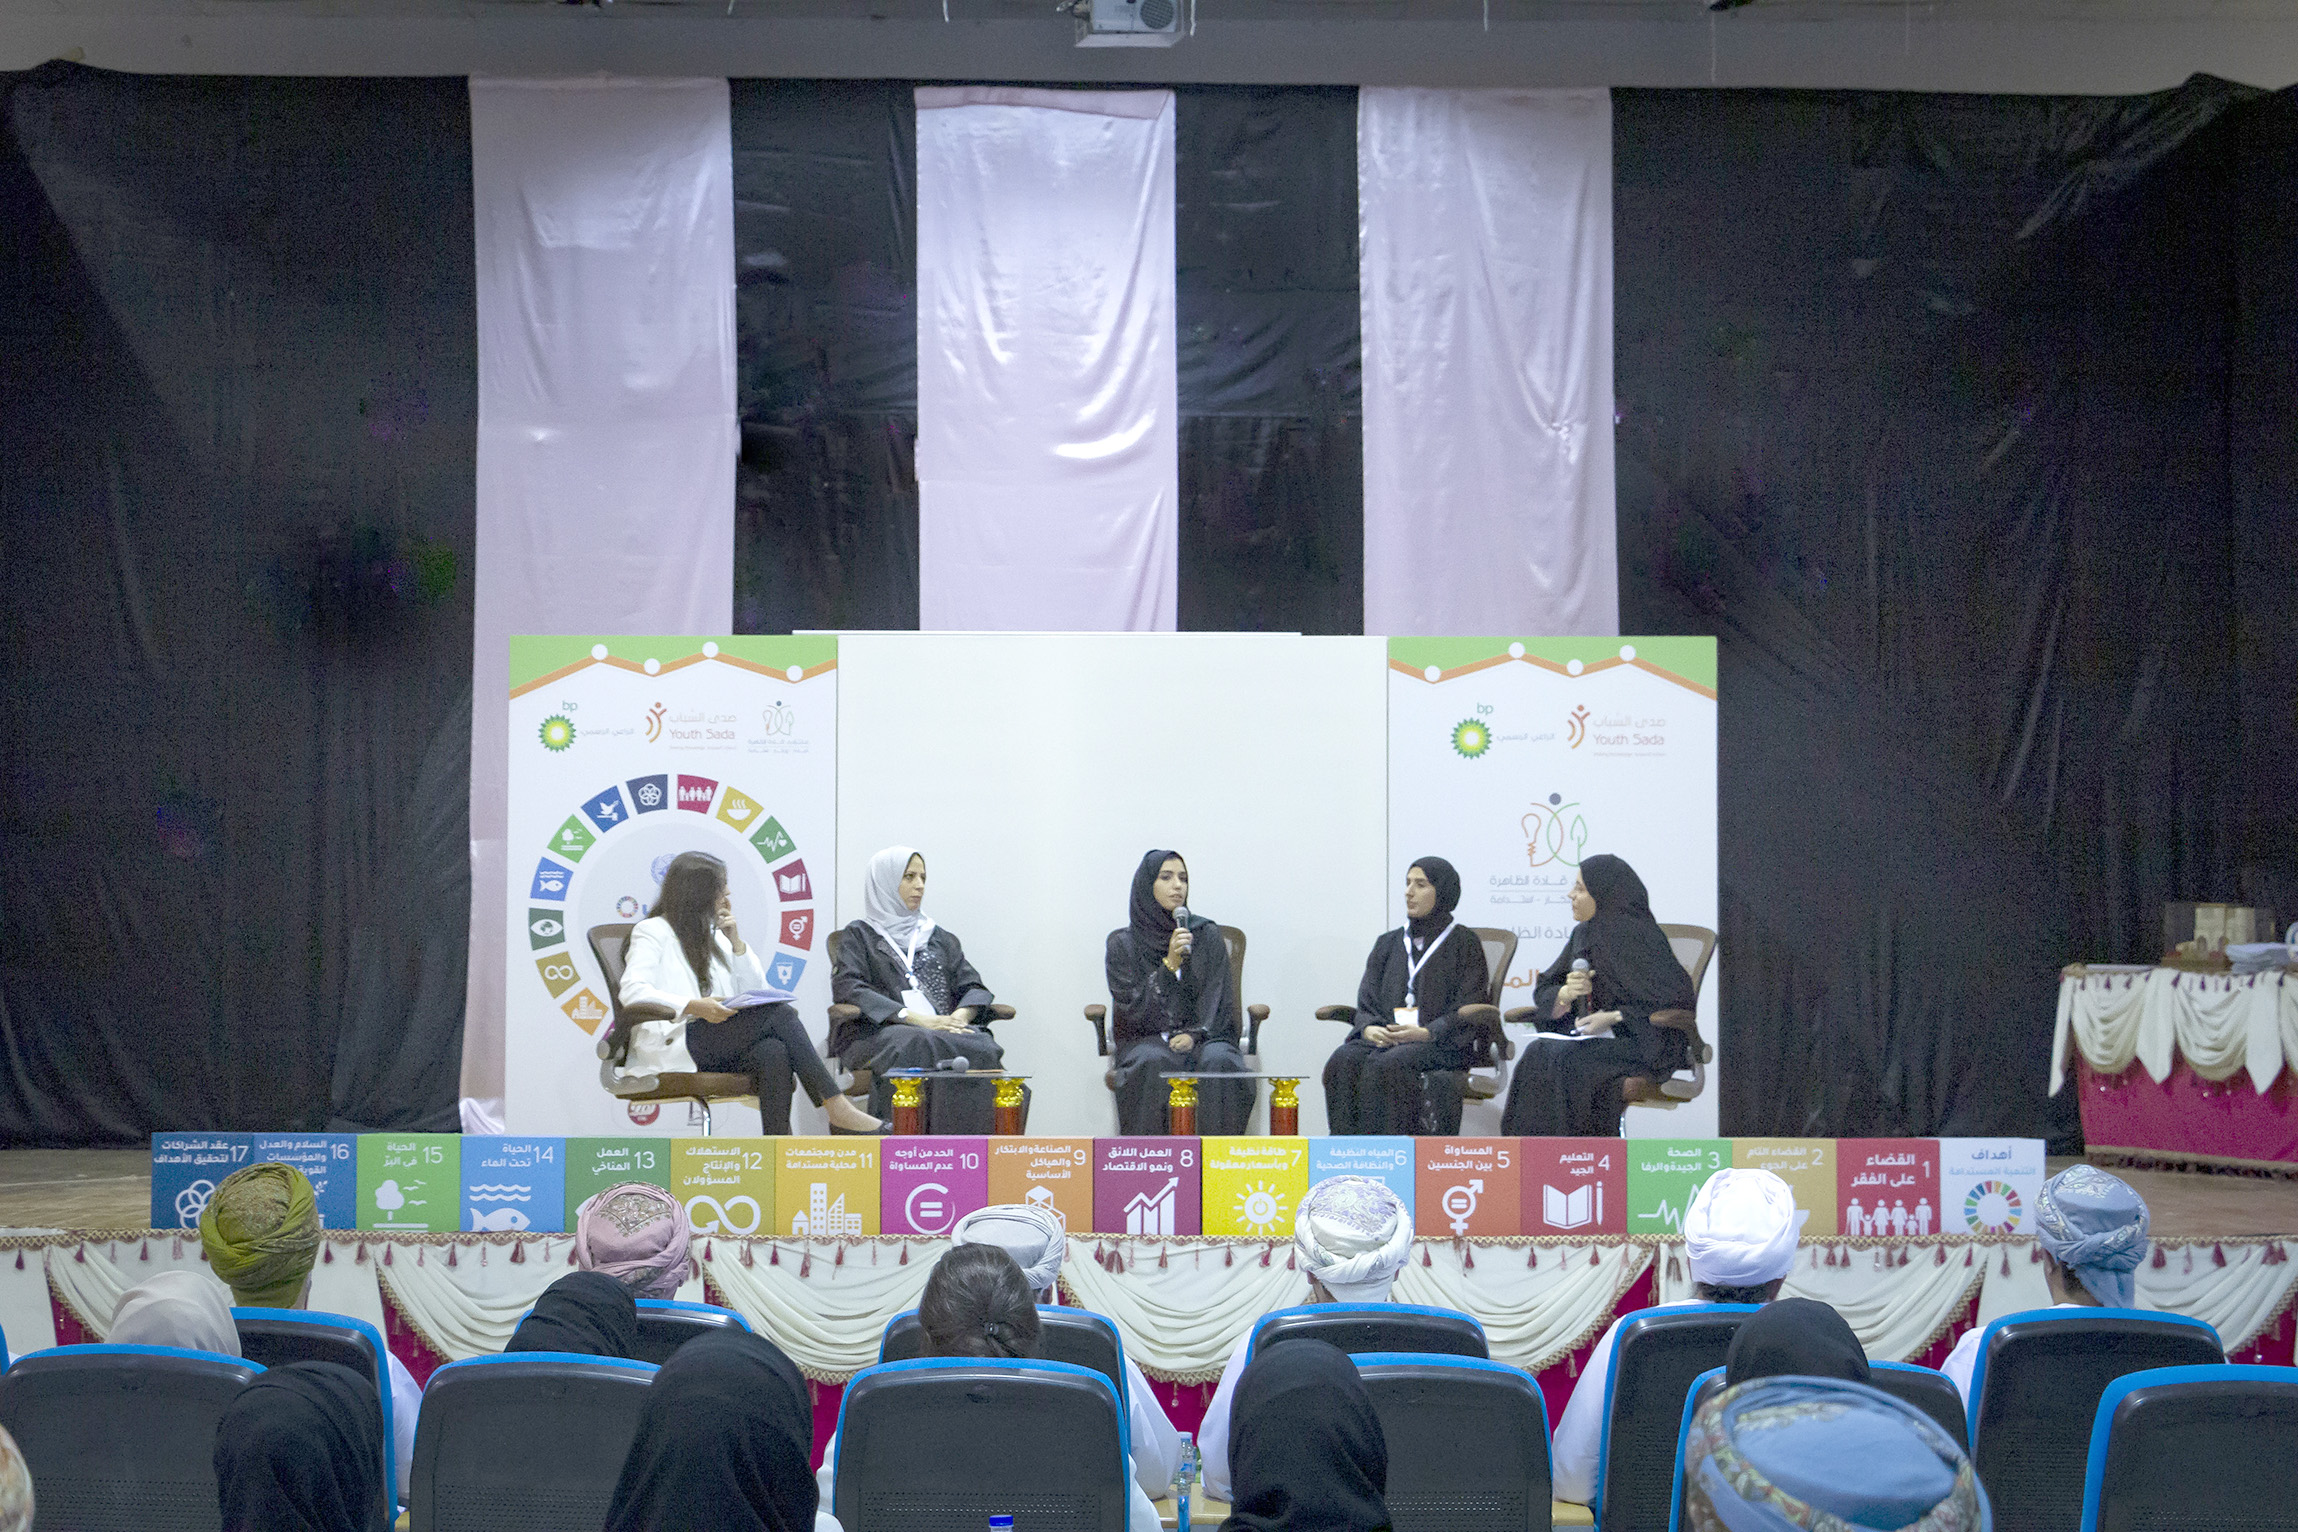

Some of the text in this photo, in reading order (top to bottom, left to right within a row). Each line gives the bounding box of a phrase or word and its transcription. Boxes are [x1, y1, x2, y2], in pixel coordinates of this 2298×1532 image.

[562, 701, 578, 712] bp
[1477, 702, 1494, 715] bp
[669, 728, 736, 740] Youth Sada
[1593, 733, 1665, 746] Youth Sada
[161, 1139, 229, 1151] عقد الشراكات
[259, 1140, 327, 1150] السلام والعدل
[387, 1142, 416, 1153] الحياة
[502, 1144, 531, 1154] الحياة
[1444, 1145, 1493, 1155] المساواة
[1771, 1146, 1807, 1156] القضاء
[230, 1145, 249, 1163] 17
[266, 1152, 327, 1163] والمؤسسات
[330, 1143, 350, 1160] 16
[422, 1146, 443, 1164] 15
[533, 1146, 554, 1164] 14
[596, 1148, 629, 1158] العمل
[685, 1147, 740, 1156] الاستهلاك
[785, 1148, 856, 1158] مدن ومجتمعات
[895, 1146, 953, 1158] الحد من أوجه
[1073, 1149, 1086, 1166] 9
[1108, 1147, 1172, 1159] العمل اللائق
[1229, 1146, 1286, 1157] طاقة نظيفة
[1330, 1148, 1394, 1158] المياه النظيفة
[1667, 1147, 1701, 1157] الصحة
[1812, 1148, 1824, 1166] 2
[1971, 1146, 2012, 1160] أهداف
[153, 1152, 229, 1165] لتحقيق الأهداف
[481, 1158, 531, 1168] تحت الماء
[634, 1151, 655, 1169] 13
[742, 1152, 762, 1170] 12
[859, 1152, 873, 1168] 11
[959, 1153, 979, 1170] 10
[1030, 1158, 1071, 1168] والهياكل
[1179, 1149, 1194, 1168] 8
[1210, 1158, 1288, 1170] وبأسعار معقولة
[1291, 1150, 1302, 1167] 7
[1394, 1150, 1407, 1166] 6
[1497, 1151, 1511, 1169] 5
[1559, 1153, 1594, 1163] التعليم
[1598, 1155, 1610, 1171] 4
[1707, 1151, 1721, 1169] 3
[1866, 1154, 1915, 1166] القضاء
[592, 1162, 630, 1175] المناخي
[702, 1160, 741, 1174] والإنتاج
[786, 1160, 857, 1171] محلية مستدامة
[889, 1161, 954, 1172] عدم المساواة
[1102, 1162, 1173, 1173] ونمو الاقتصاد
[1316, 1160, 1394, 1171] والنظافة الصحية
[1427, 1160, 1493, 1171] بين الجنسين
[1570, 1166, 1594, 1176] الجيد
[1789, 1161, 1808, 1171] على
[1922, 1161, 1930, 1178] 1
[683, 1176, 740, 1186] المسؤولان
[1026, 1170, 1071, 1180] الأساسية
[1851, 1173, 1915, 1187] على الفقر
